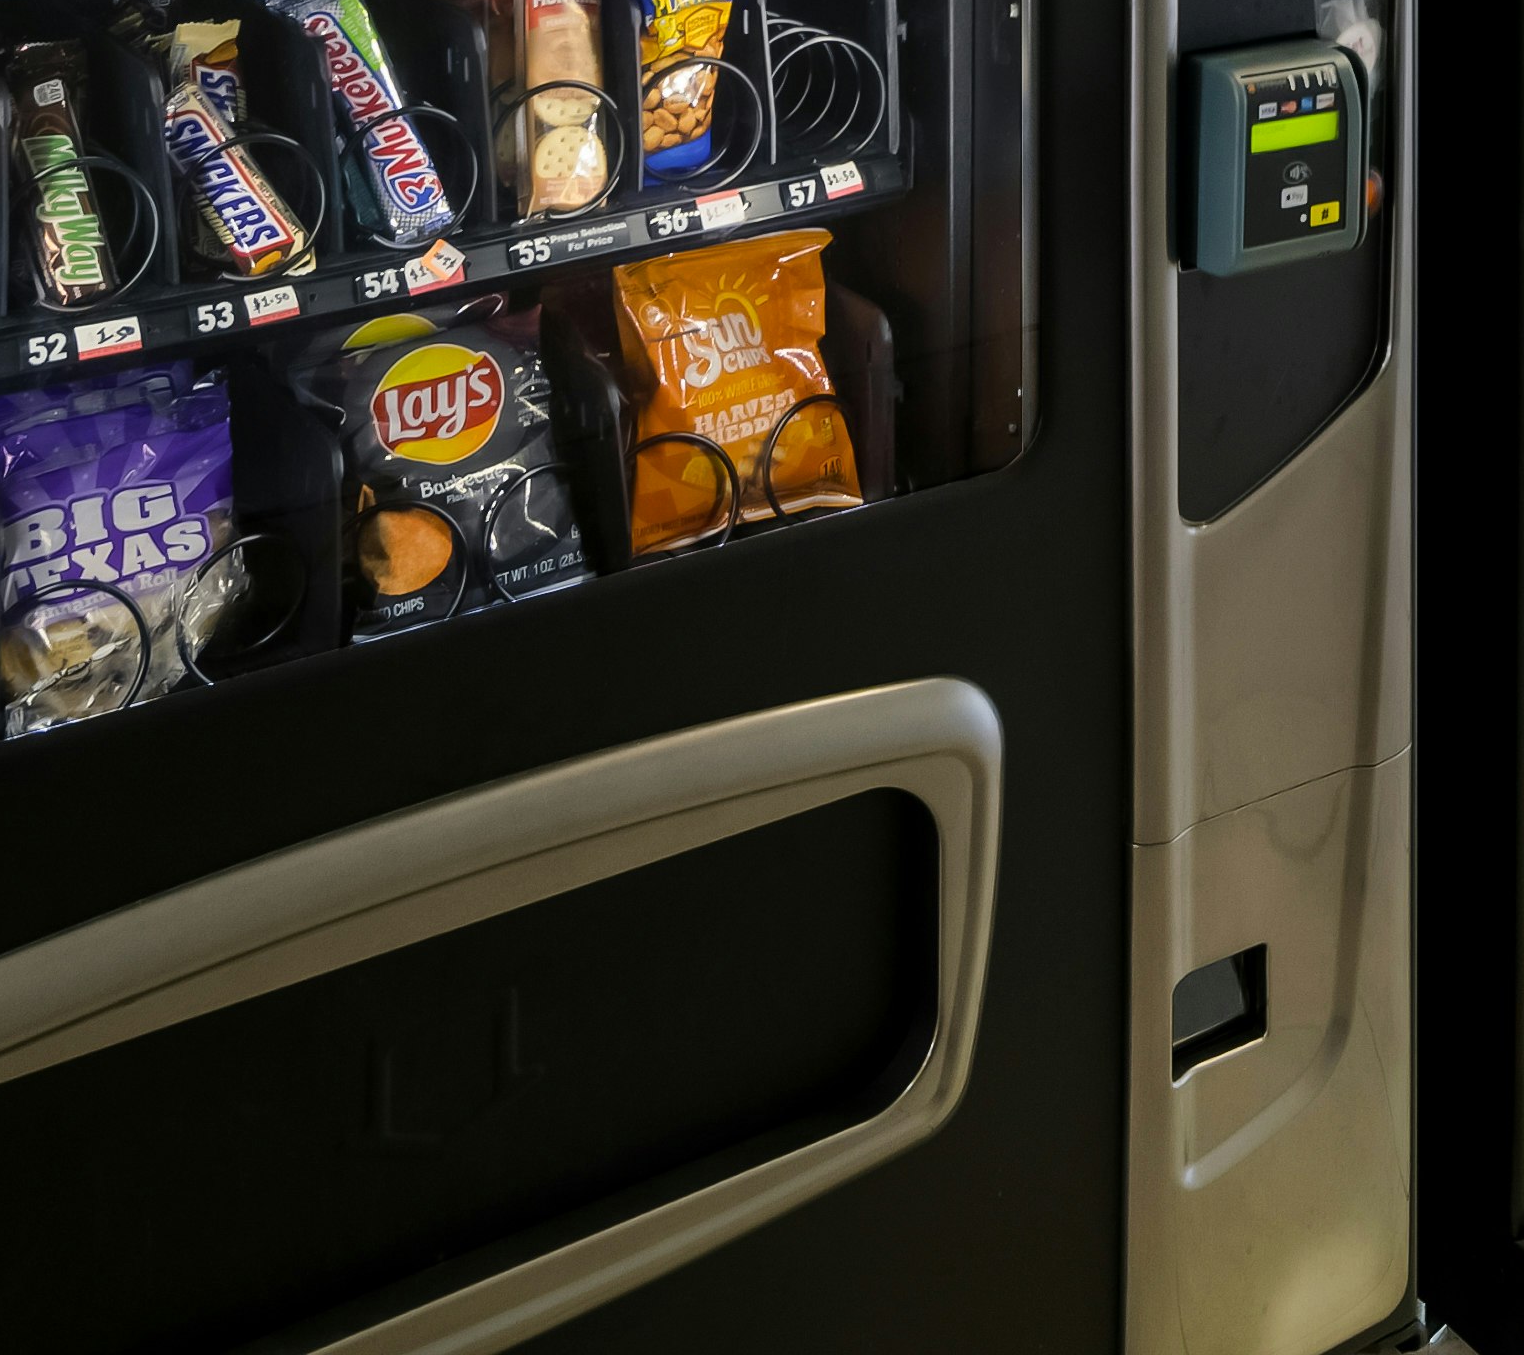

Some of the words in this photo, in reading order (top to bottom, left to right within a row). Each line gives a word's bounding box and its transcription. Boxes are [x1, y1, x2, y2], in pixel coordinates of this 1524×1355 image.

[49, 79, 64, 104] 240
[397, 175, 444, 203] 3
[788, 179, 817, 208] 57
[364, 272, 400, 300] 54
[197, 300, 235, 333] 53
[28, 332, 68, 366] 52
[680, 312, 763, 389] Sun
[722, 346, 772, 373] CHIPS
[383, 362, 493, 443] Lay's
[693, 388, 797, 433] HARVEST
[1, 482, 177, 568] BIG
[1, 519, 208, 611] TEXAS
[392, 596, 425, 618] CHIPS
